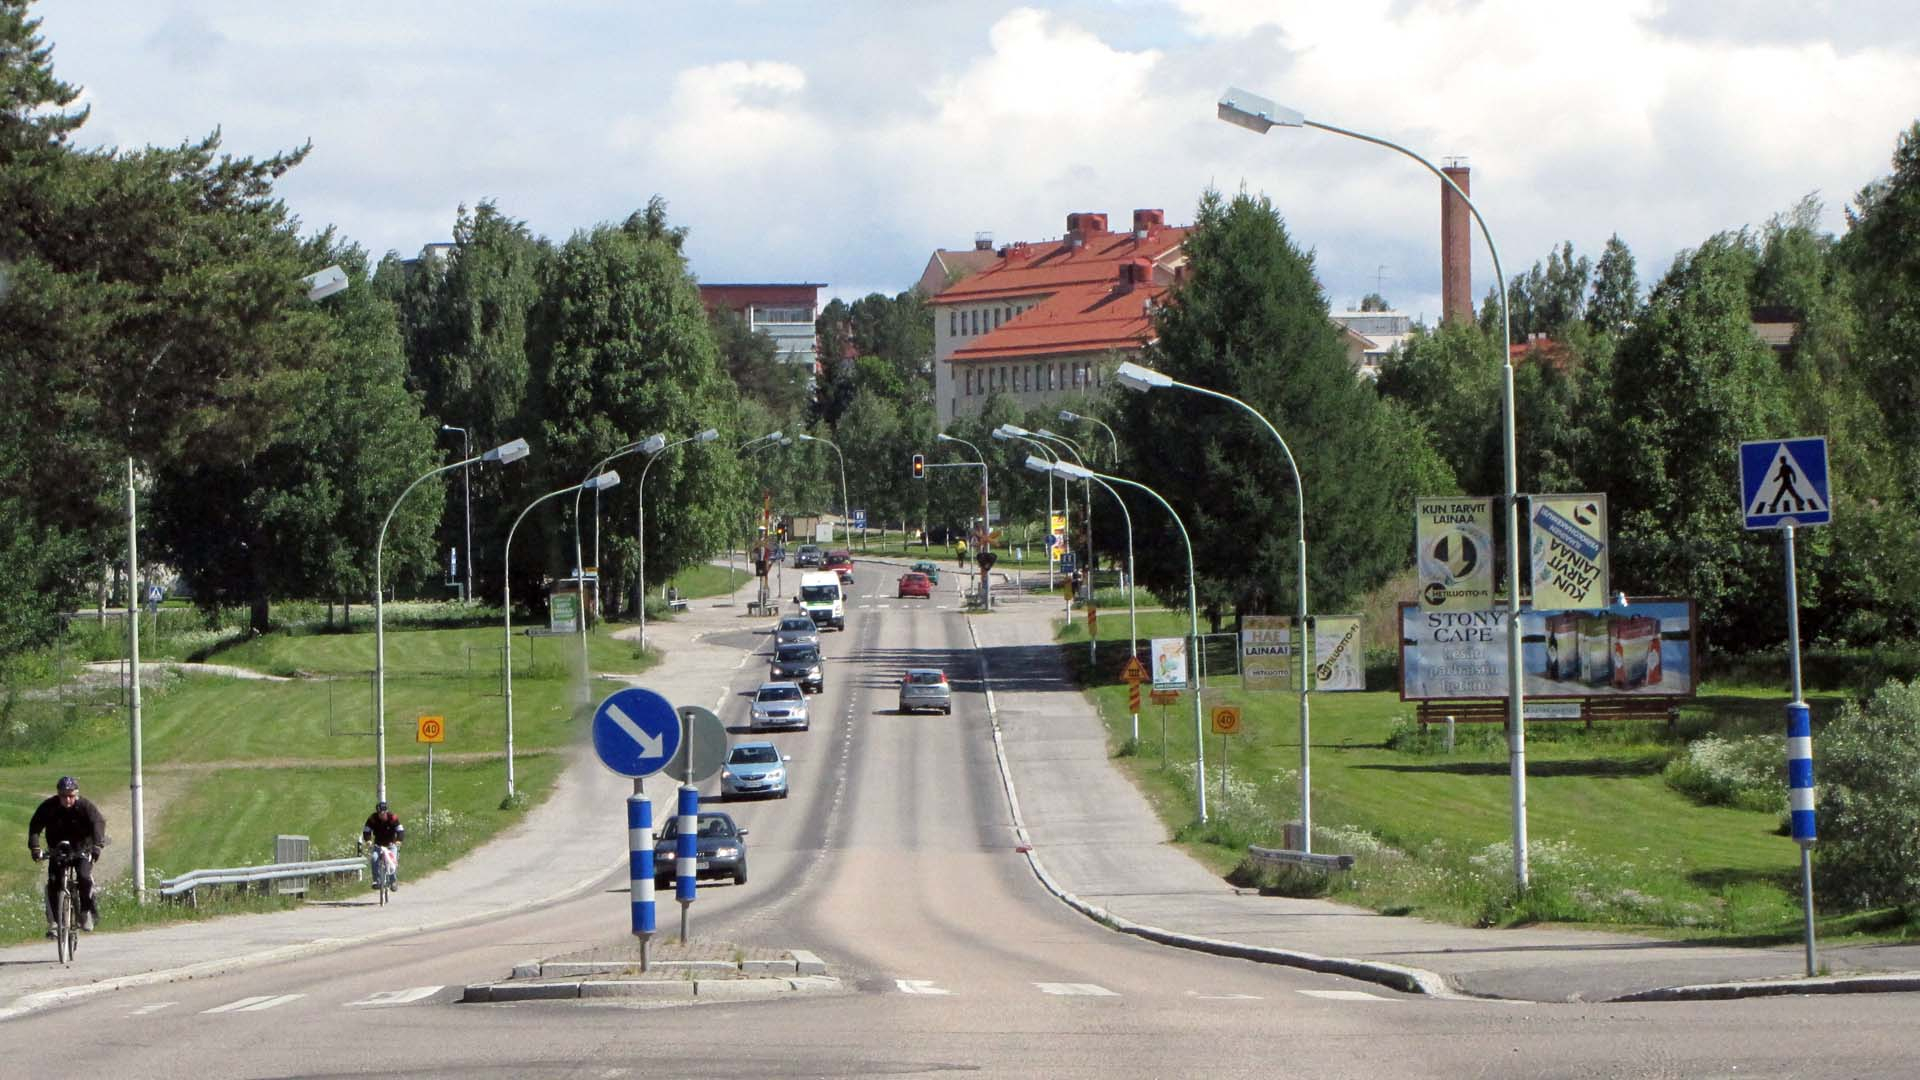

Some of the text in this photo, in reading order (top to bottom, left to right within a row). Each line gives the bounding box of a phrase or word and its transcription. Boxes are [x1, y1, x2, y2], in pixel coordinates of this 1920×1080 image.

[1422, 503, 1486, 515] KUN TARVIT
[1433, 514, 1476, 524] LAINAA
[1550, 537, 1601, 580] LAINAA
[1547, 555, 1594, 593] TARVIT
[1552, 577, 1586, 602] KUN
[1428, 611, 1501, 628] STONY
[1252, 631, 1281, 642] HAE
[1434, 627, 1494, 642] CAPE
[1220, 715, 1232, 724] 40
[425, 724, 437, 734] 40
